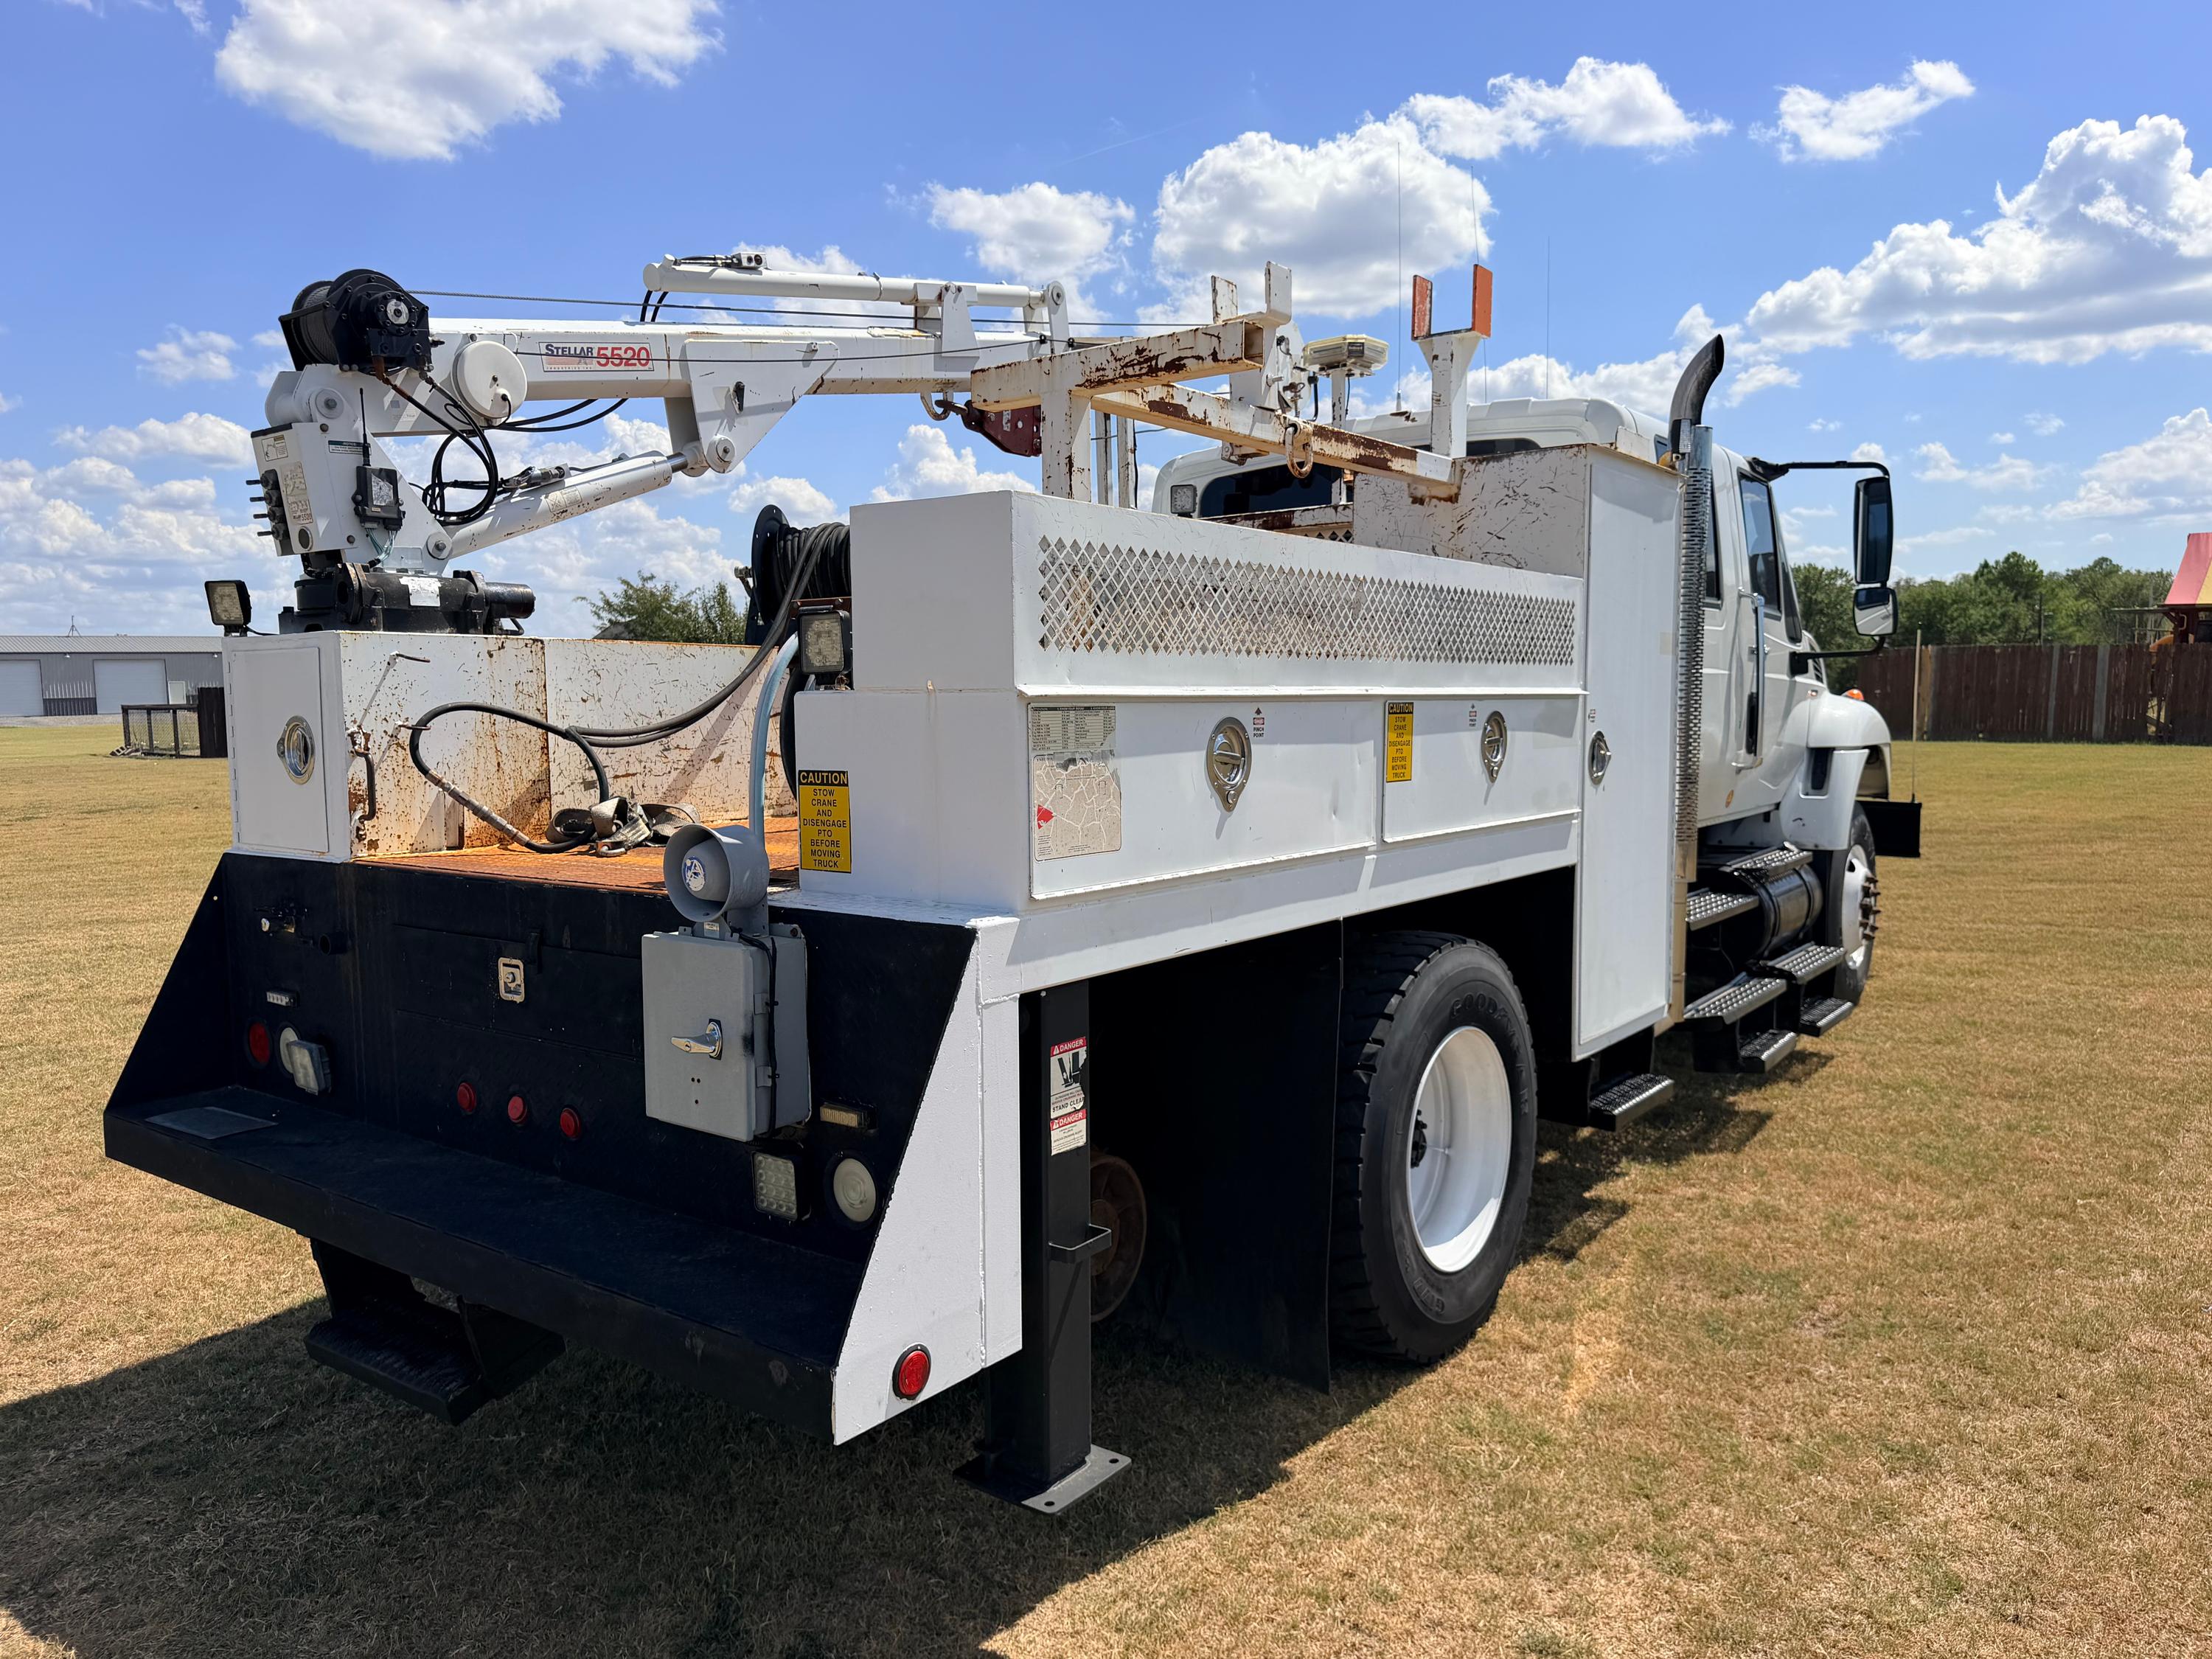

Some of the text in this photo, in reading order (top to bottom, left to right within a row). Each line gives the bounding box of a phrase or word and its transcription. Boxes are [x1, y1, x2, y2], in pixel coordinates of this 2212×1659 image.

[545, 344, 650, 367] STELLAR 5520
[1388, 703, 1413, 713] CAUTION
[800, 772, 847, 784] CAUTION
[813, 788, 835, 796] STOW
[811, 799, 837, 807] CRANE
[816, 809, 832, 817] AND
[803, 818, 847, 828] DISENGAGE
[818, 829, 832, 838] PTO
[810, 838, 841, 848] BEFORE
[810, 849, 841, 858] MOVING
[813, 859, 838, 868] TRUCK
[1060, 1039, 1083, 1052] DANGER
[1052, 1102, 1069, 1113] STAND
[1059, 1112, 1083, 1126] DANGER
